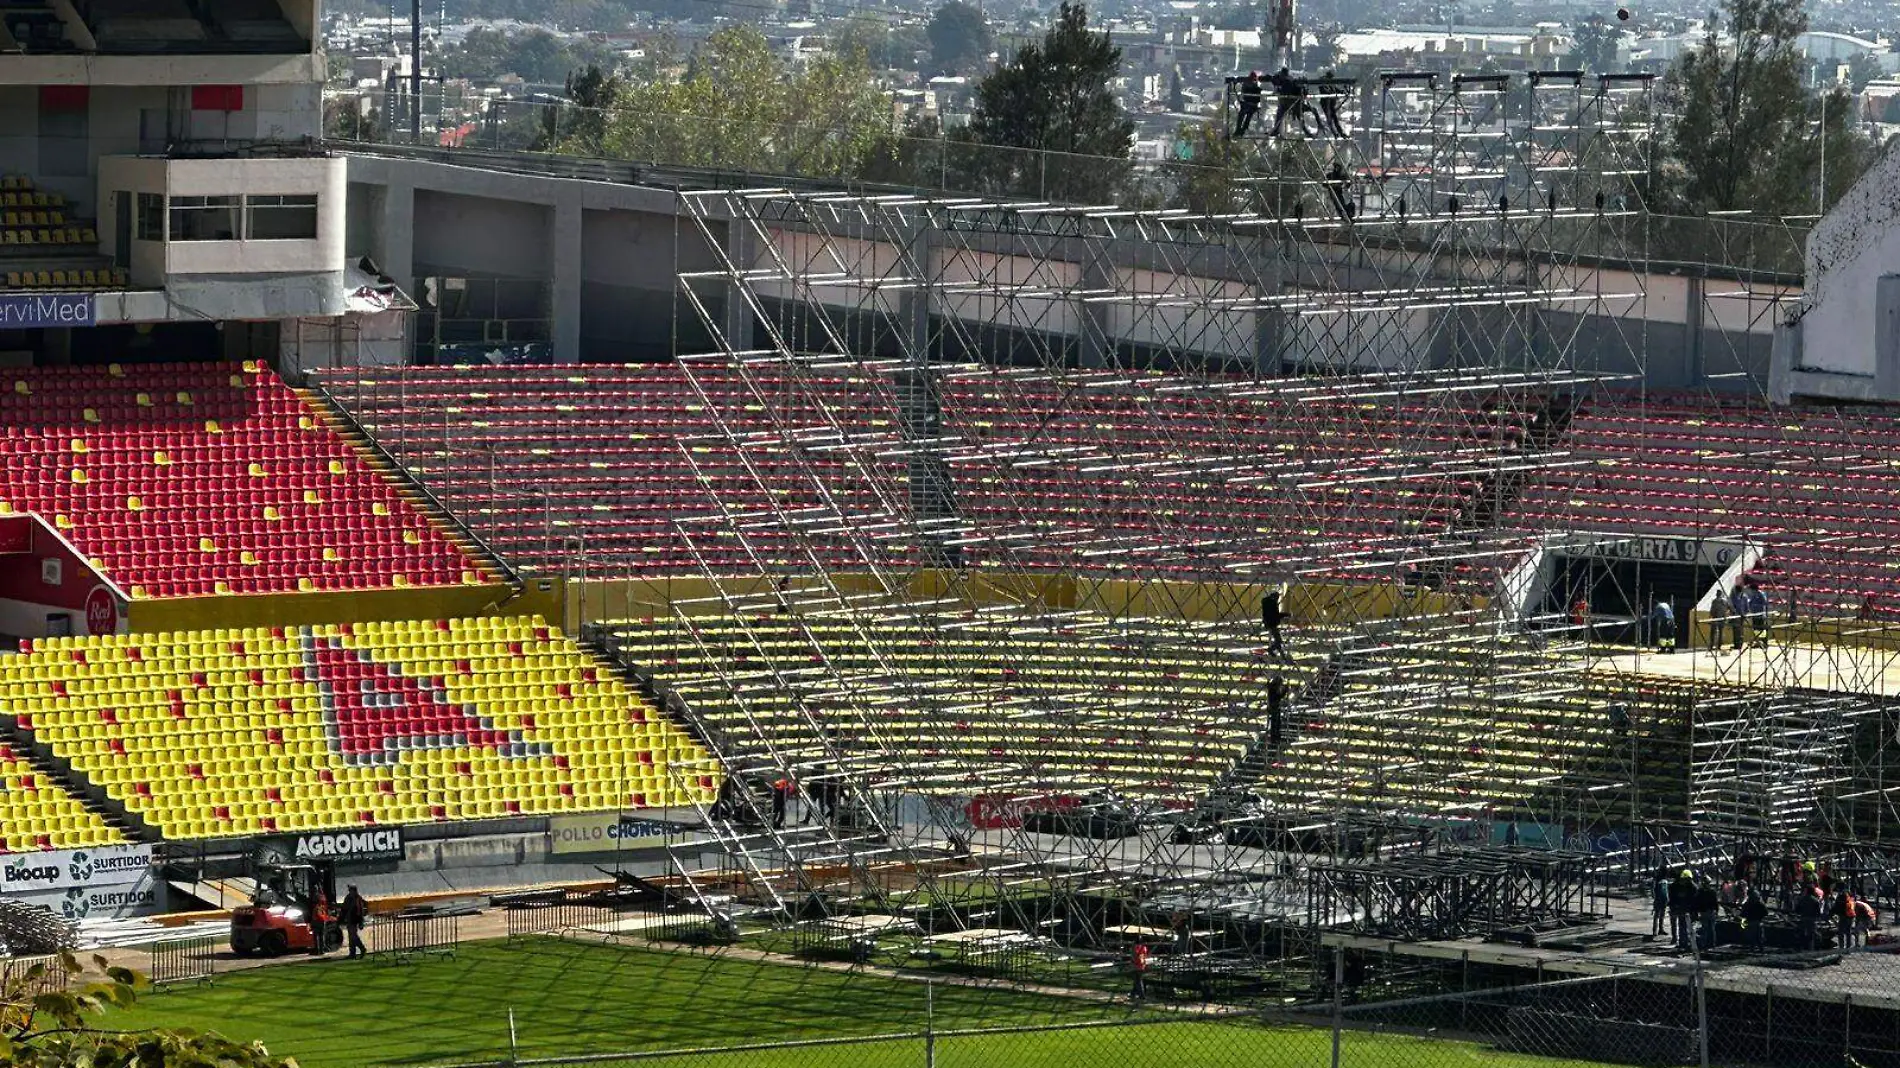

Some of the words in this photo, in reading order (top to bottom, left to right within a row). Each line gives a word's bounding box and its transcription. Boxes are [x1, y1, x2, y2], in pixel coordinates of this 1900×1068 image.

[1603, 538, 1679, 560] PUERTA
[1684, 541, 1697, 560] 9
[90, 599, 111, 620] Red
[295, 830, 400, 857] AGROMICH
[552, 826, 602, 842] POLLO
[4, 862, 60, 883] Biocup
[93, 855, 151, 869] SURTIDOR
[90, 891, 155, 906] SURTIDOR
